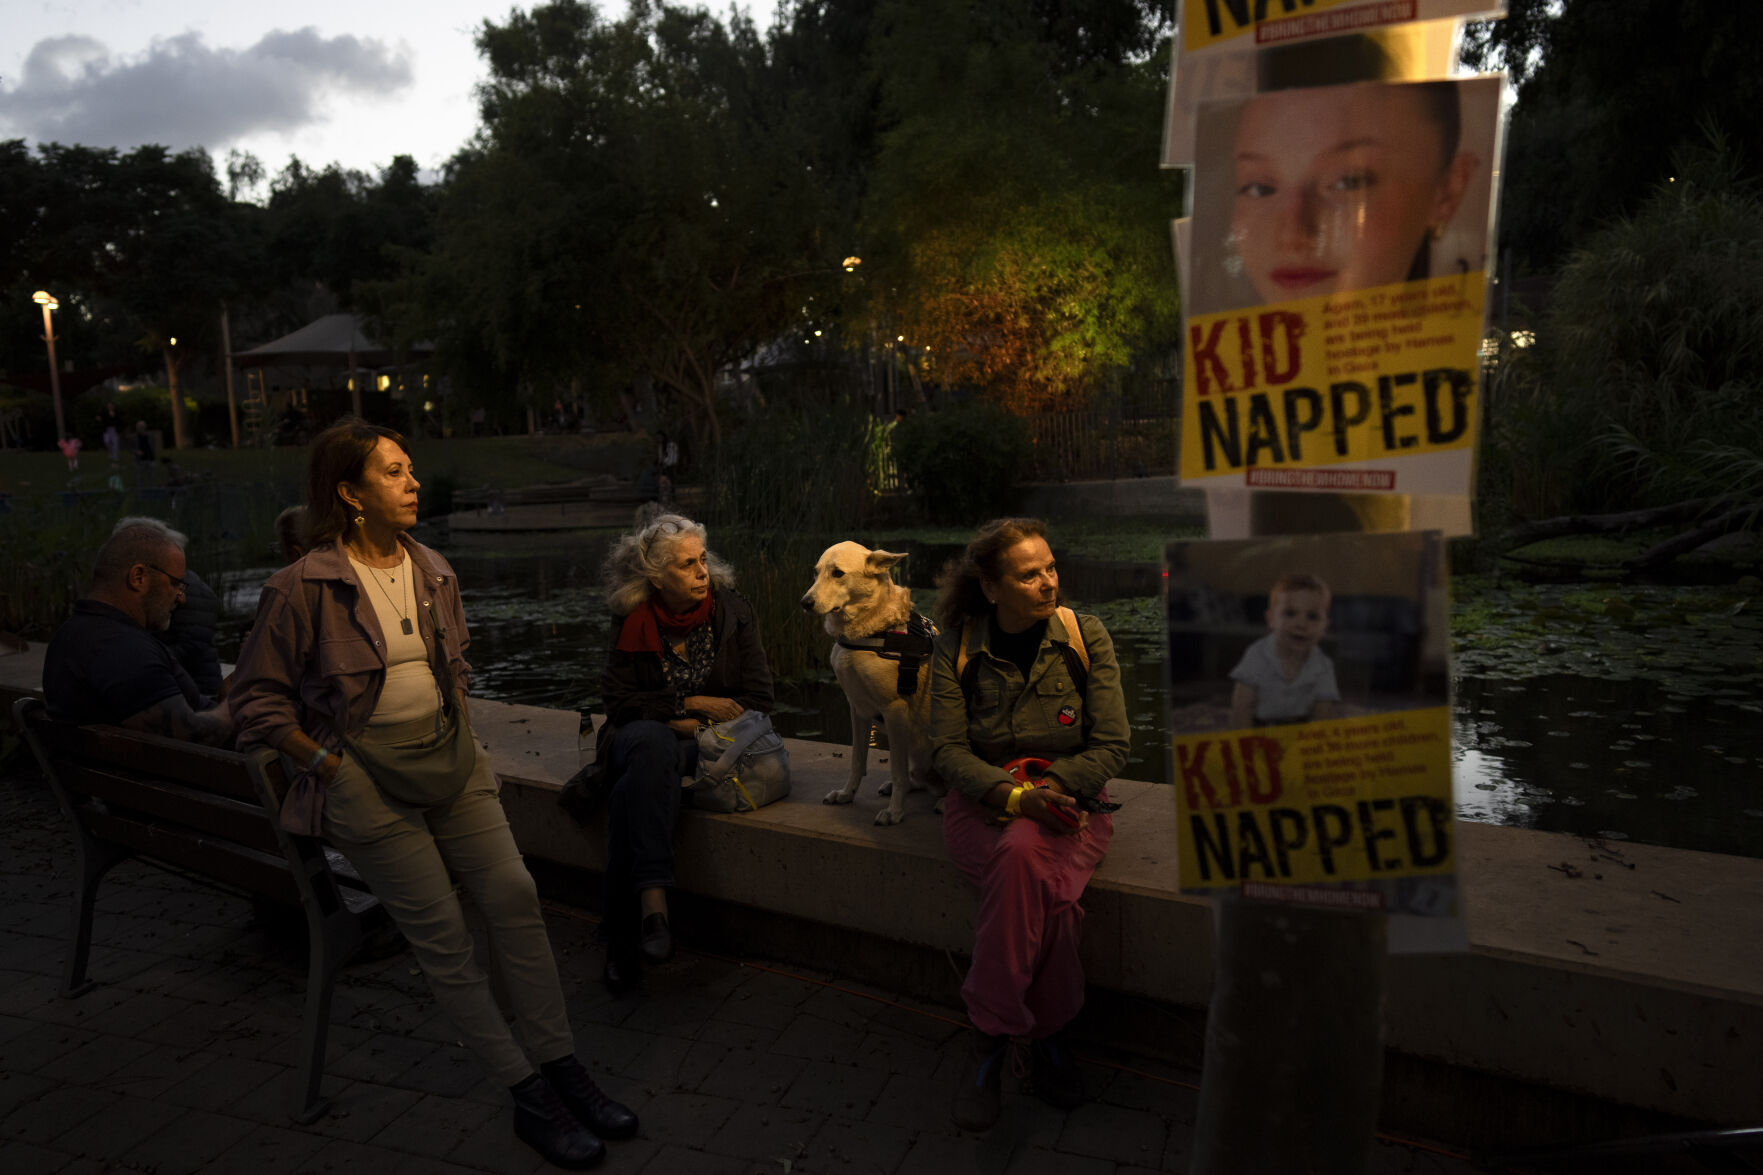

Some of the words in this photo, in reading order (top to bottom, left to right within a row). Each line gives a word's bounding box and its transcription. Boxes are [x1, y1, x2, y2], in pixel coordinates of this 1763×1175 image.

[1350, 328, 1388, 342] being
[1391, 321, 1422, 334] held
[1191, 310, 1306, 395] KID
[1325, 344, 1380, 360] hostage
[1384, 341, 1401, 354] by
[1406, 335, 1455, 348] Hamas
[1345, 361, 1379, 373] Gaza
[1199, 368, 1472, 469] NAPPED
[1365, 750, 1394, 763] held
[1178, 736, 1286, 809] KID
[1304, 772, 1355, 785] hostage
[1360, 769, 1376, 782] by
[1191, 796, 1449, 880] NAPPED
